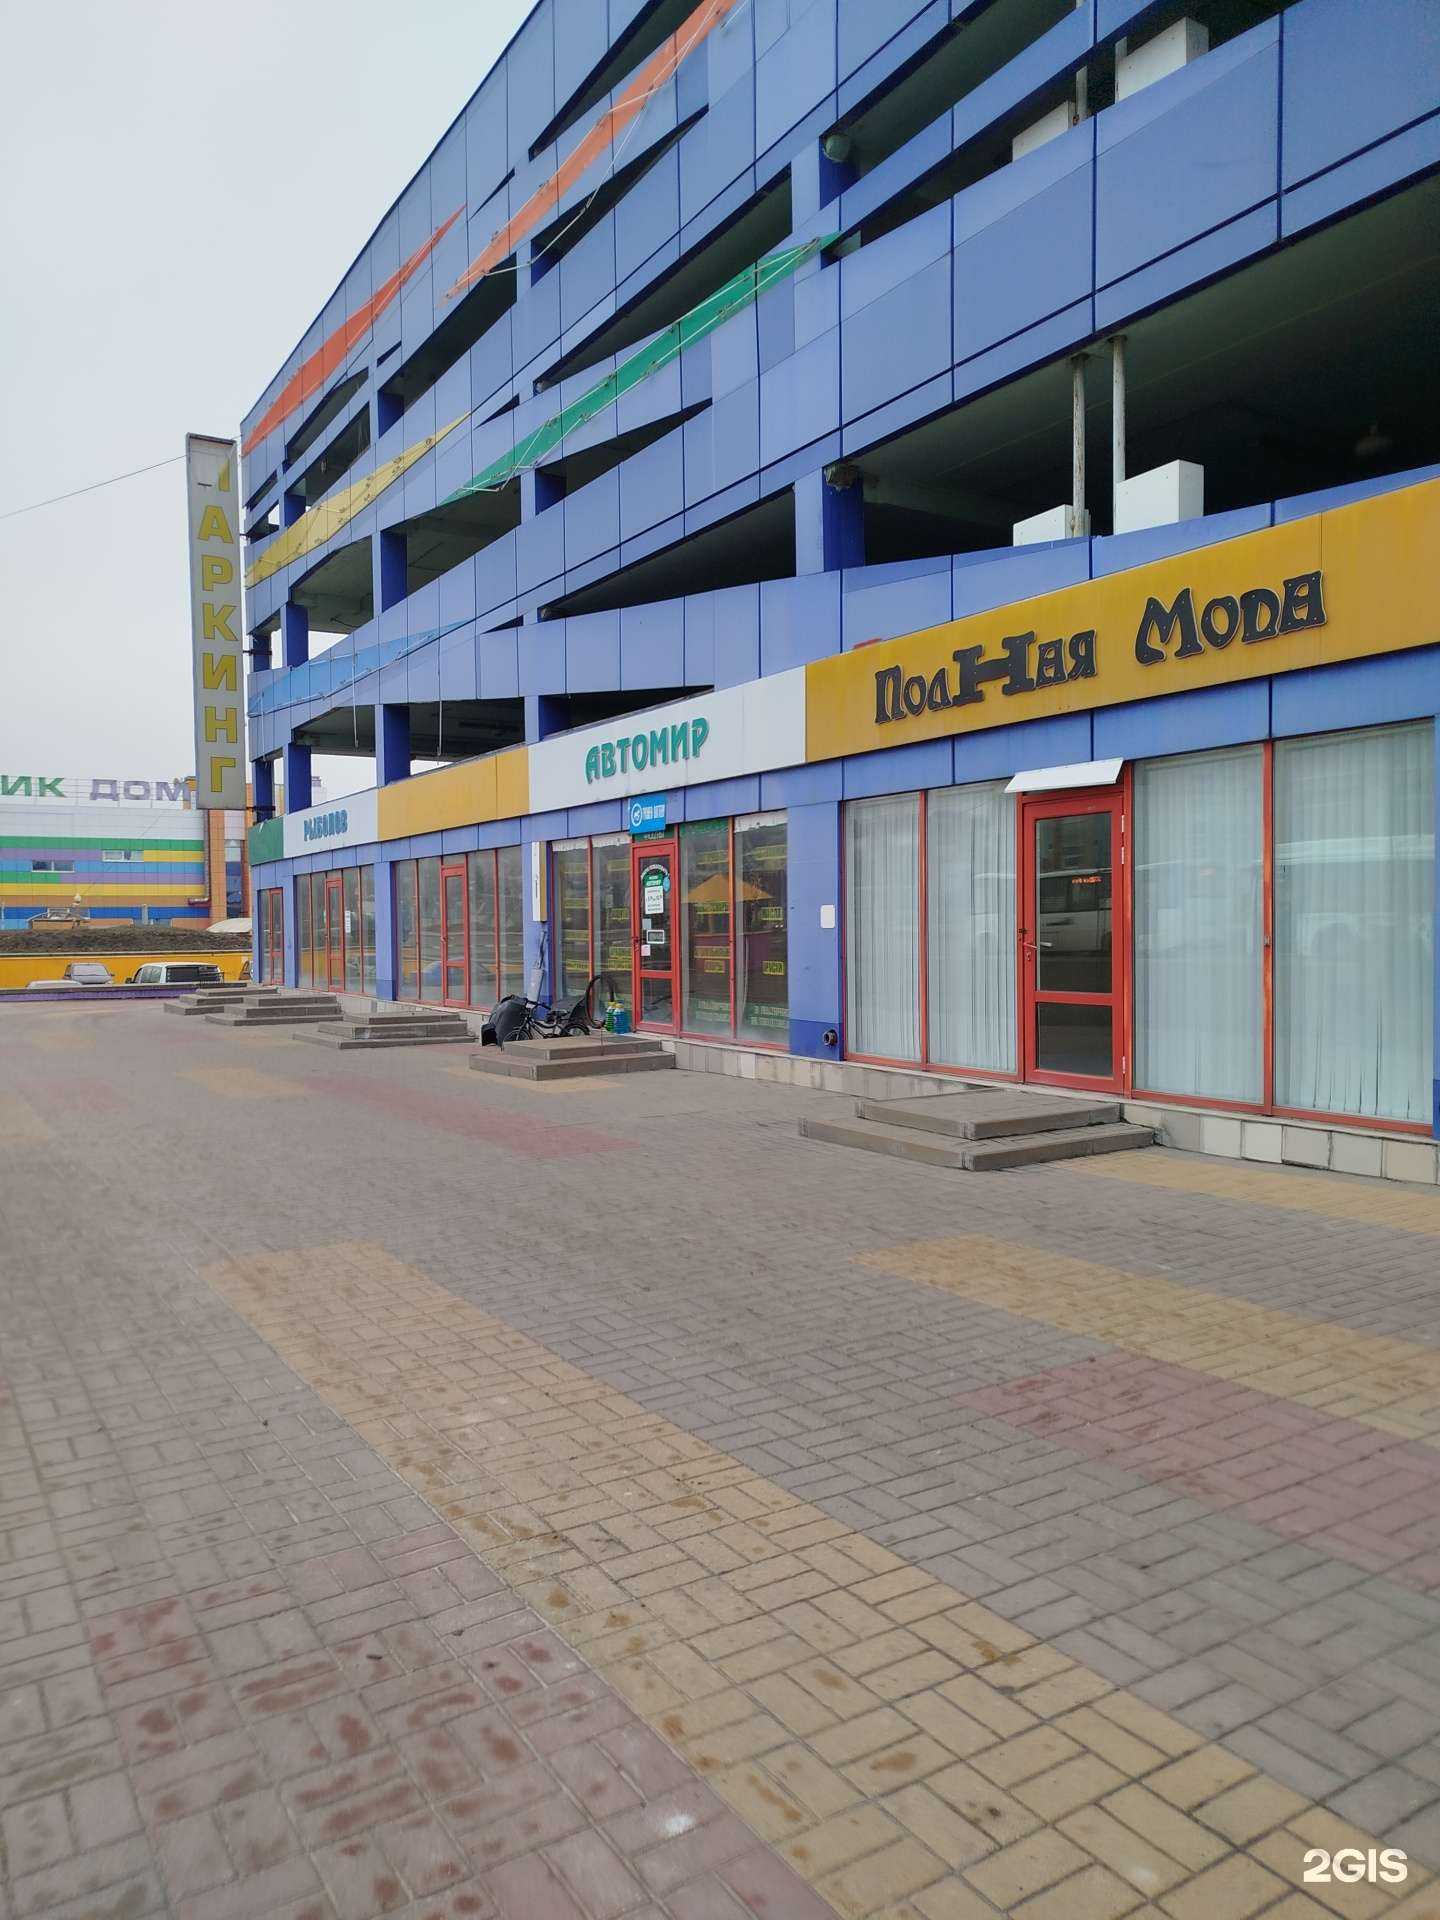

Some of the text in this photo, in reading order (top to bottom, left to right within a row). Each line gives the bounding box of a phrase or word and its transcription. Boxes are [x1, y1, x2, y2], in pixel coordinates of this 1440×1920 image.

[198, 459, 239, 793] АРКИНГ
[584, 716, 711, 785] АВТОМИР
[303, 808, 348, 842] РЫБОЛОВ
